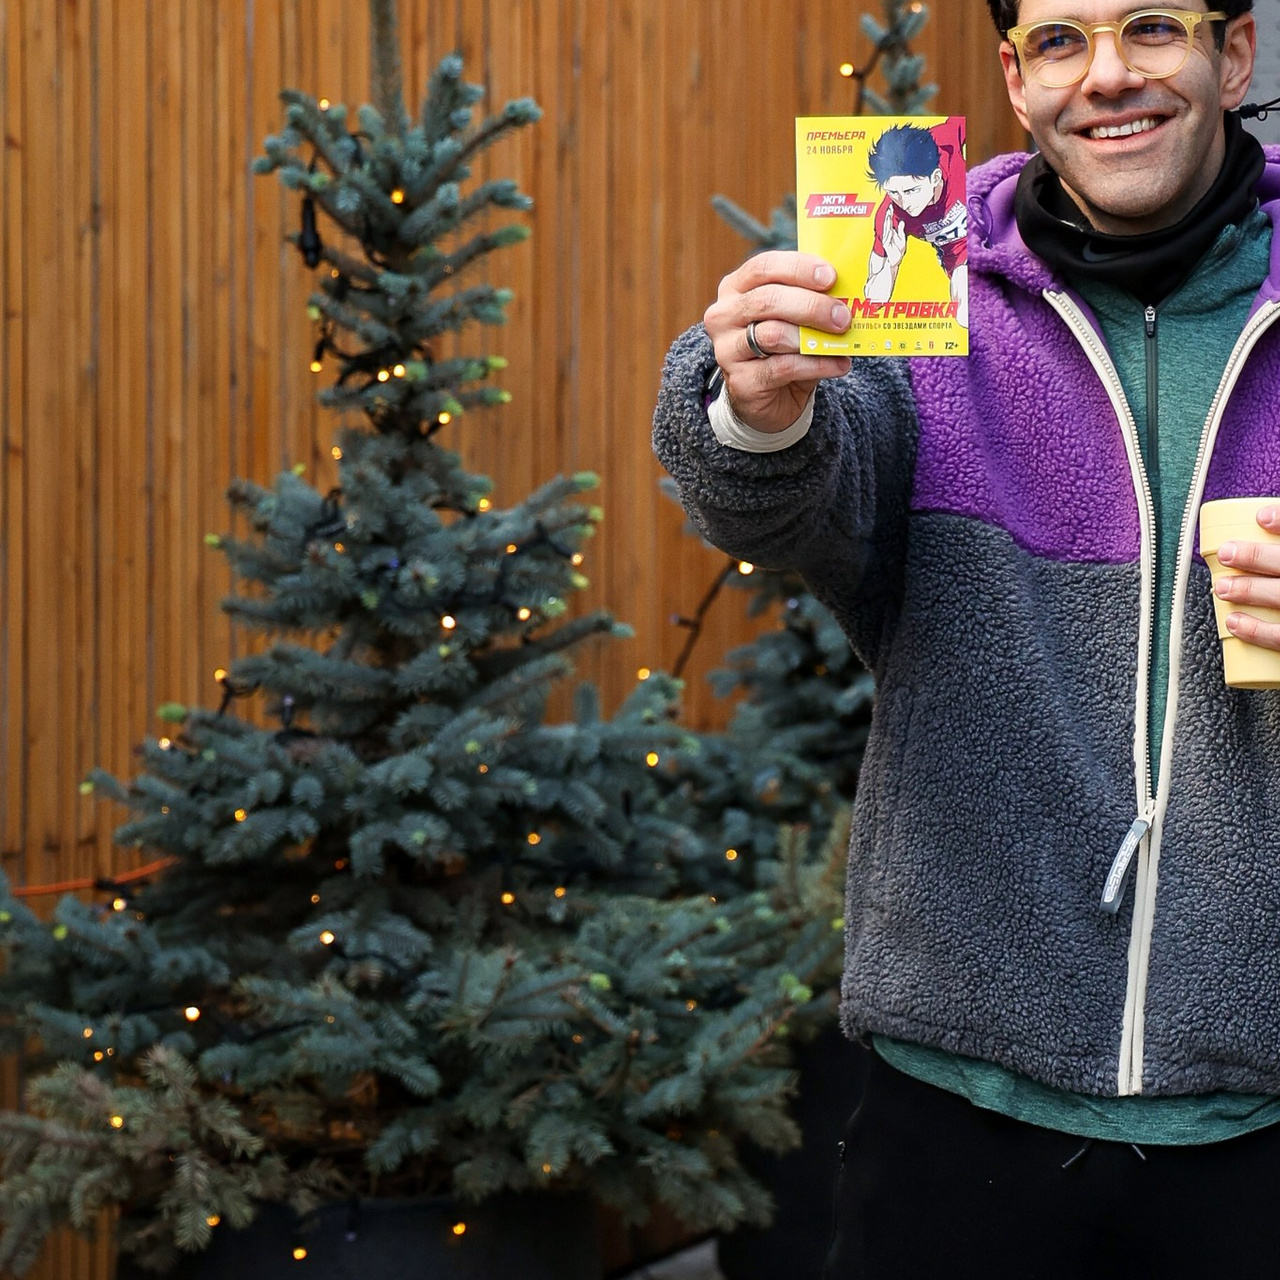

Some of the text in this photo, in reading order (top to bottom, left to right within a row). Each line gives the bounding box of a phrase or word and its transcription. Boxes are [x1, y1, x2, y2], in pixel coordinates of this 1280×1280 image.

[806, 131, 866, 141] ПРЕМЬЕРА
[807, 145, 853, 155] 24 НОЯБРЯ
[822, 195, 846, 205] ЖГИ
[813, 205, 868, 216] ДОРОЖКУ!
[893, 322, 927, 331] ЗВЕЗДАМИ
[945, 342, 959, 350] 12+
